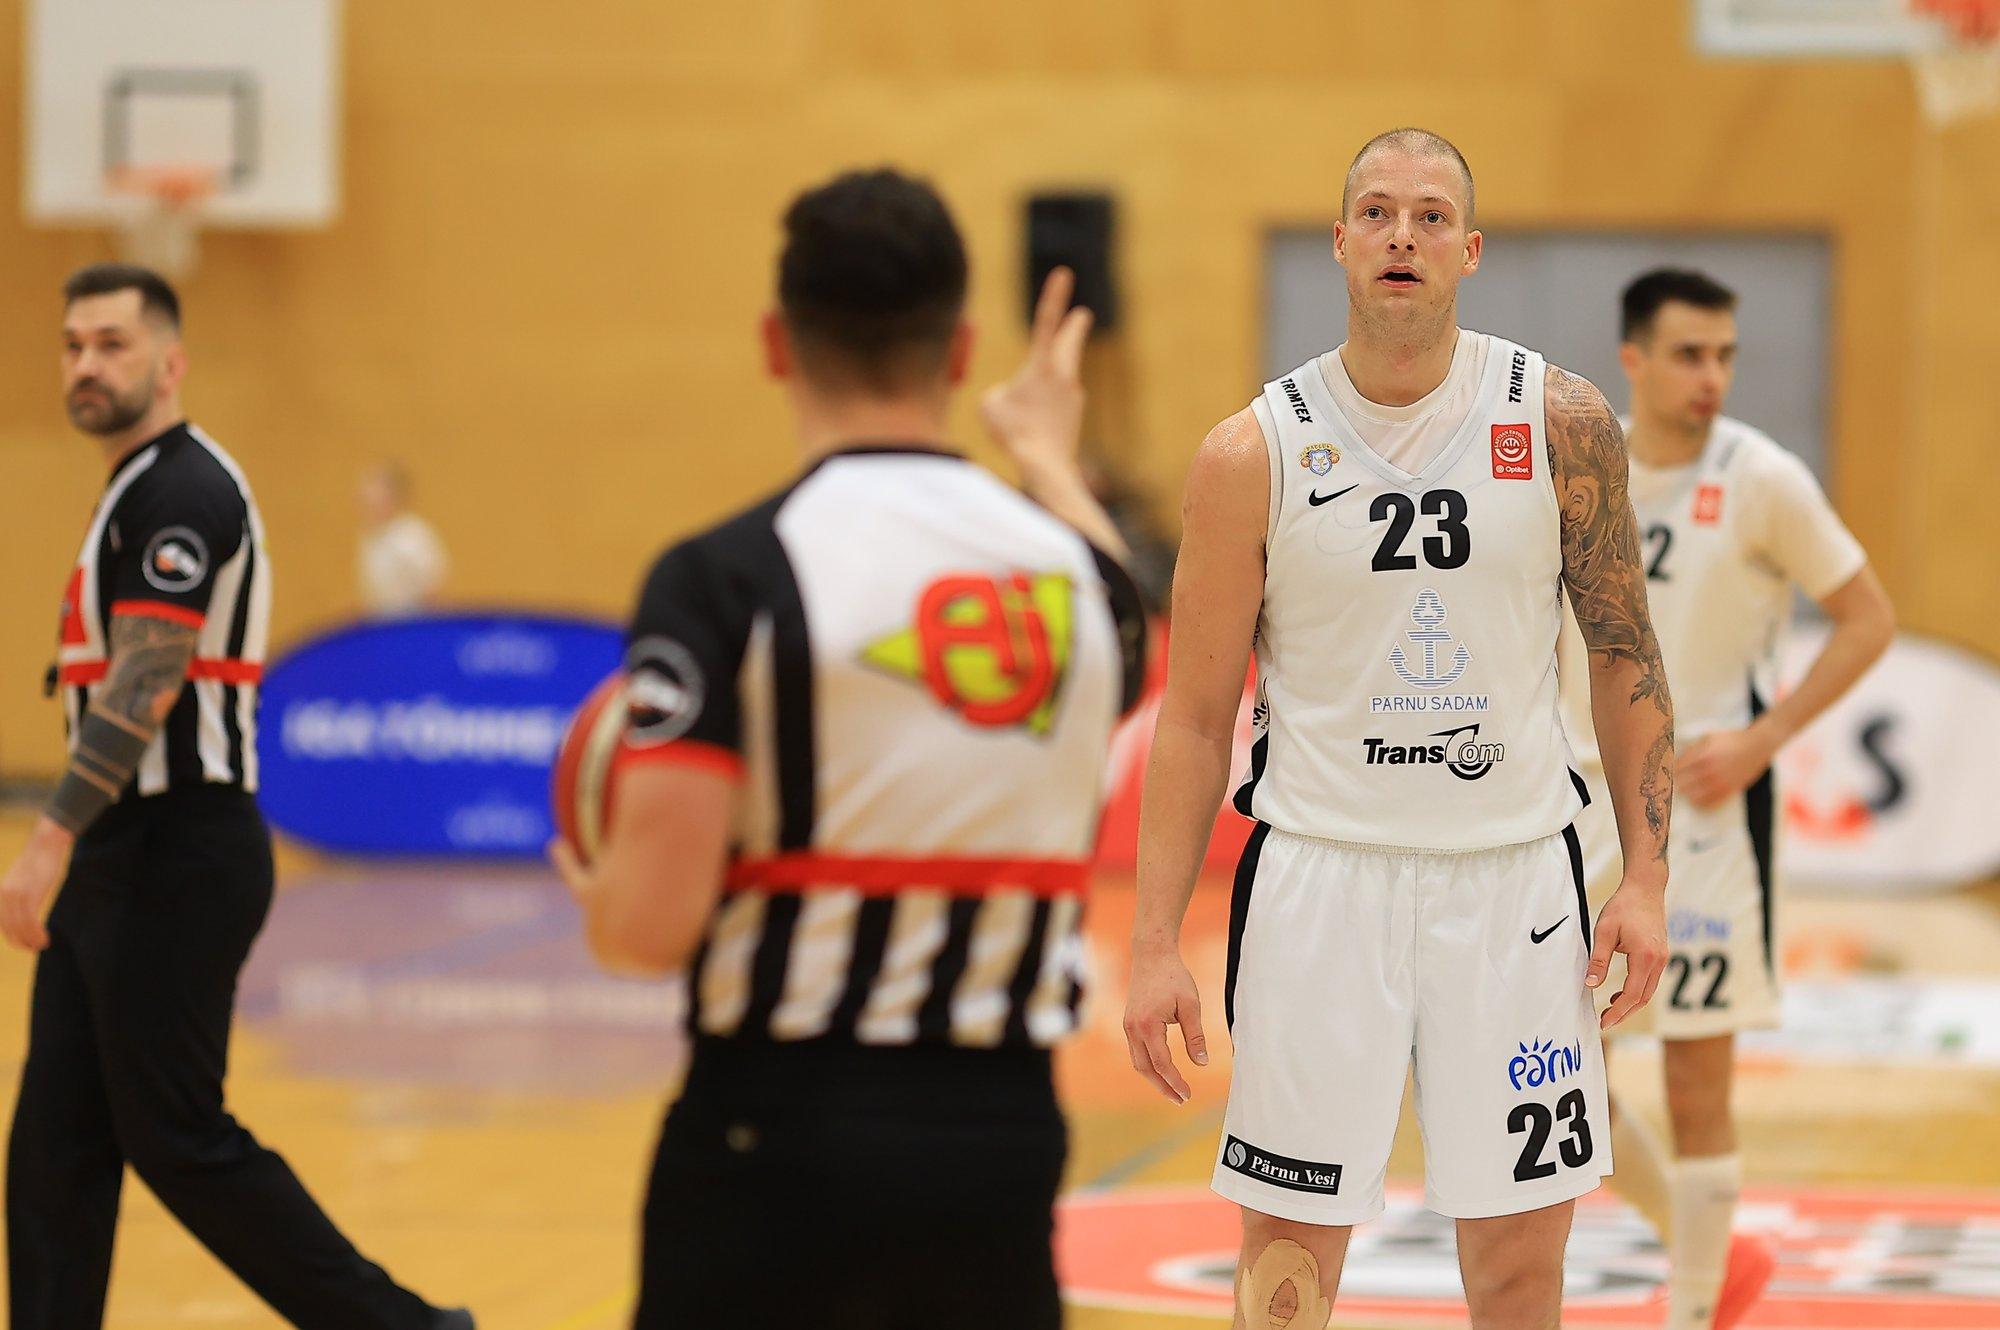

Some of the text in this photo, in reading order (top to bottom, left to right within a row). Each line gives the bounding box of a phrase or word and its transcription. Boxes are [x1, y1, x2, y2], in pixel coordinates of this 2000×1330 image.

[1280, 378, 1314, 424] TRIMTEX
[1508, 349, 1527, 403] TRIMTEX
[1505, 465, 1530, 474] Optibet
[1369, 488, 1471, 572] 23
[1372, 695, 1488, 711] PÄRNU SADAM
[1363, 723, 1505, 774] TransCom
[1667, 950, 1730, 1011] 22
[1507, 1088, 1593, 1182] 23
[1250, 1154, 1336, 1187] Pärnu Vesi
